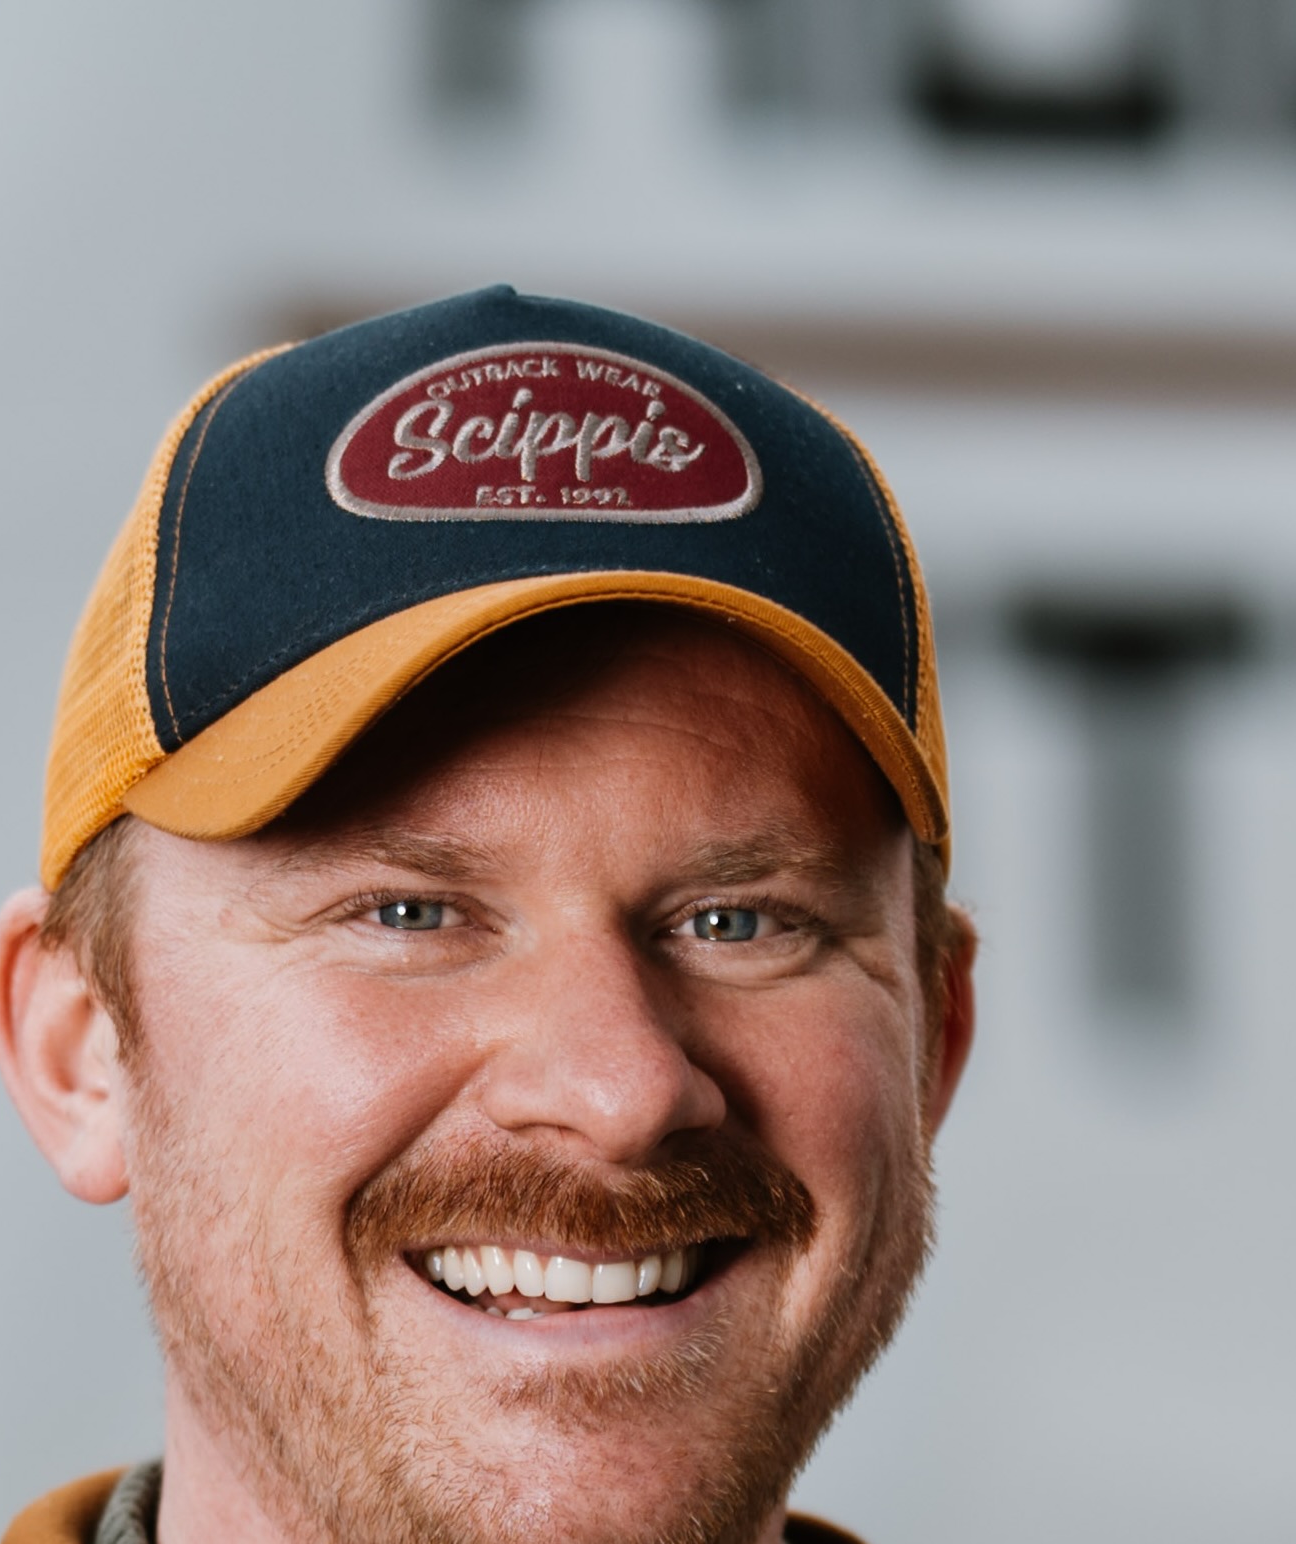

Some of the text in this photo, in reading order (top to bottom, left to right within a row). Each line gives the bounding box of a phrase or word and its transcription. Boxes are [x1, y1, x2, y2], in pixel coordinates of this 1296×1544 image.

[426, 356, 662, 400] OUTBACK WEAR
[387, 387, 704, 482] Scippis
[475, 484, 547, 507] EST.
